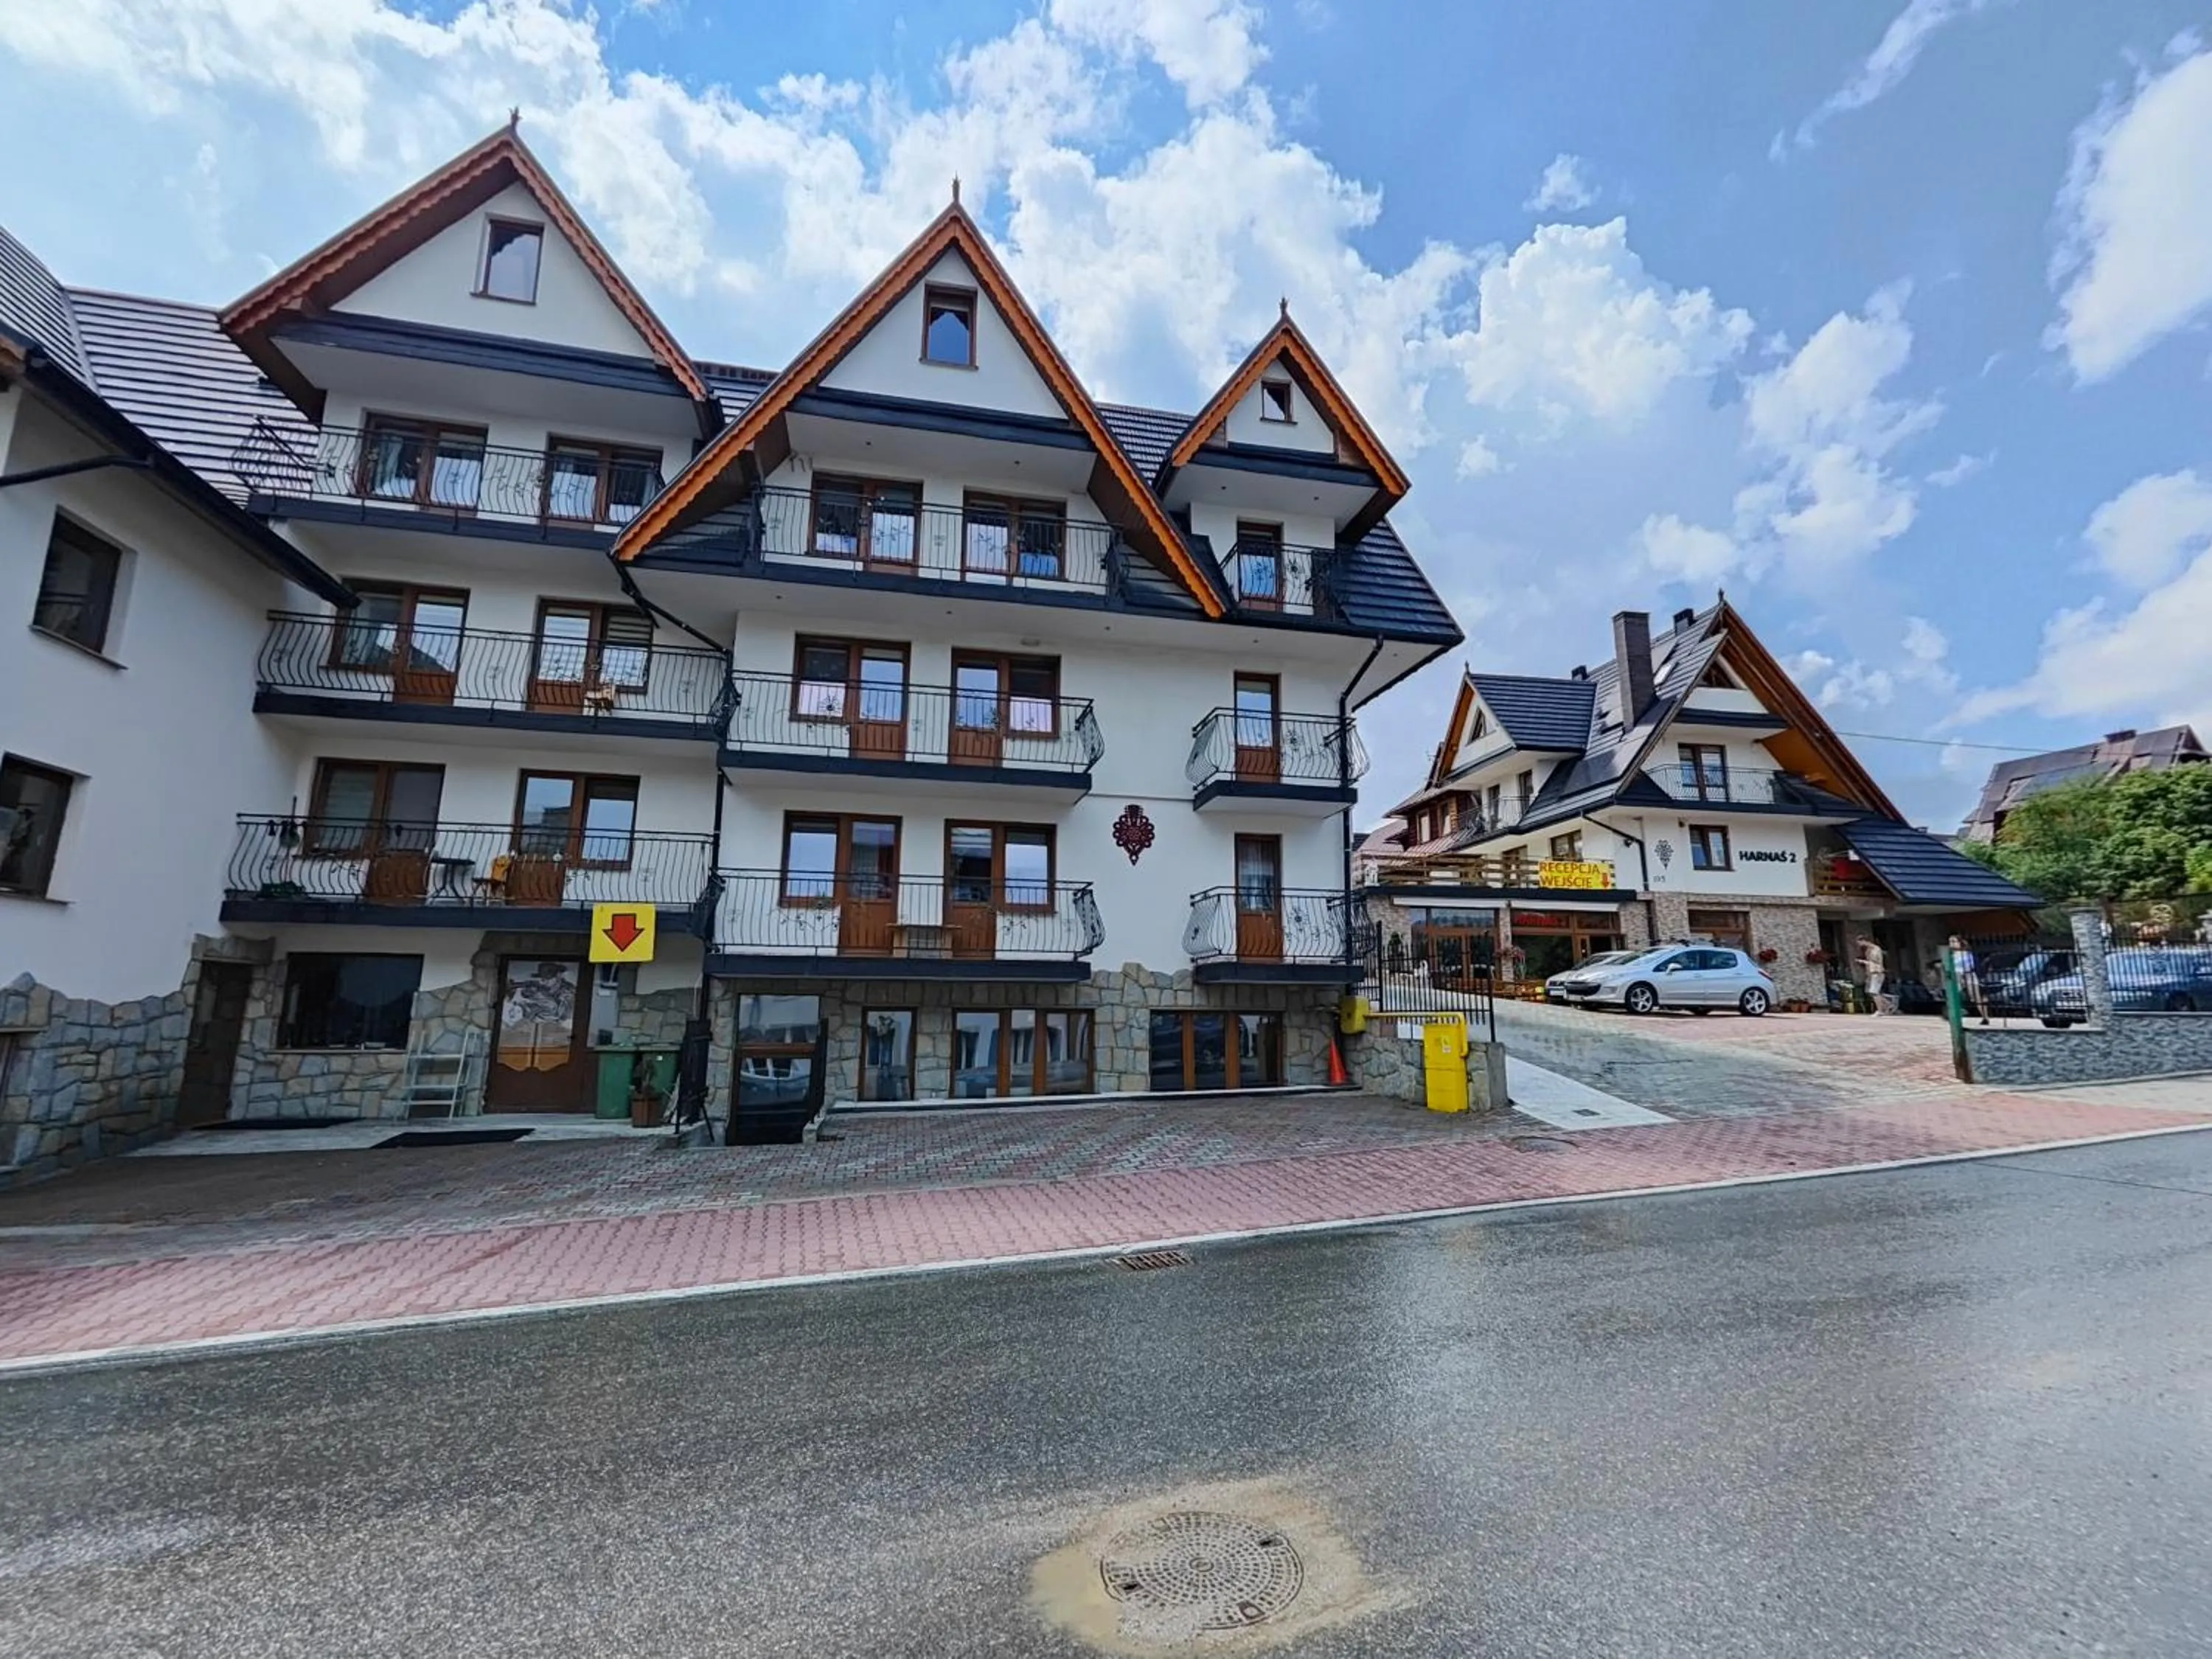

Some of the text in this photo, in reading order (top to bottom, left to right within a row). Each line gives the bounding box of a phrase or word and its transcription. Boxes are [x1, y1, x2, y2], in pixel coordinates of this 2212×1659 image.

[1739, 849, 1797, 863] HARNAŚ 2
[1539, 861, 1601, 874] RECEPCJA
[1540, 874, 1593, 888] WEJŚCIE
